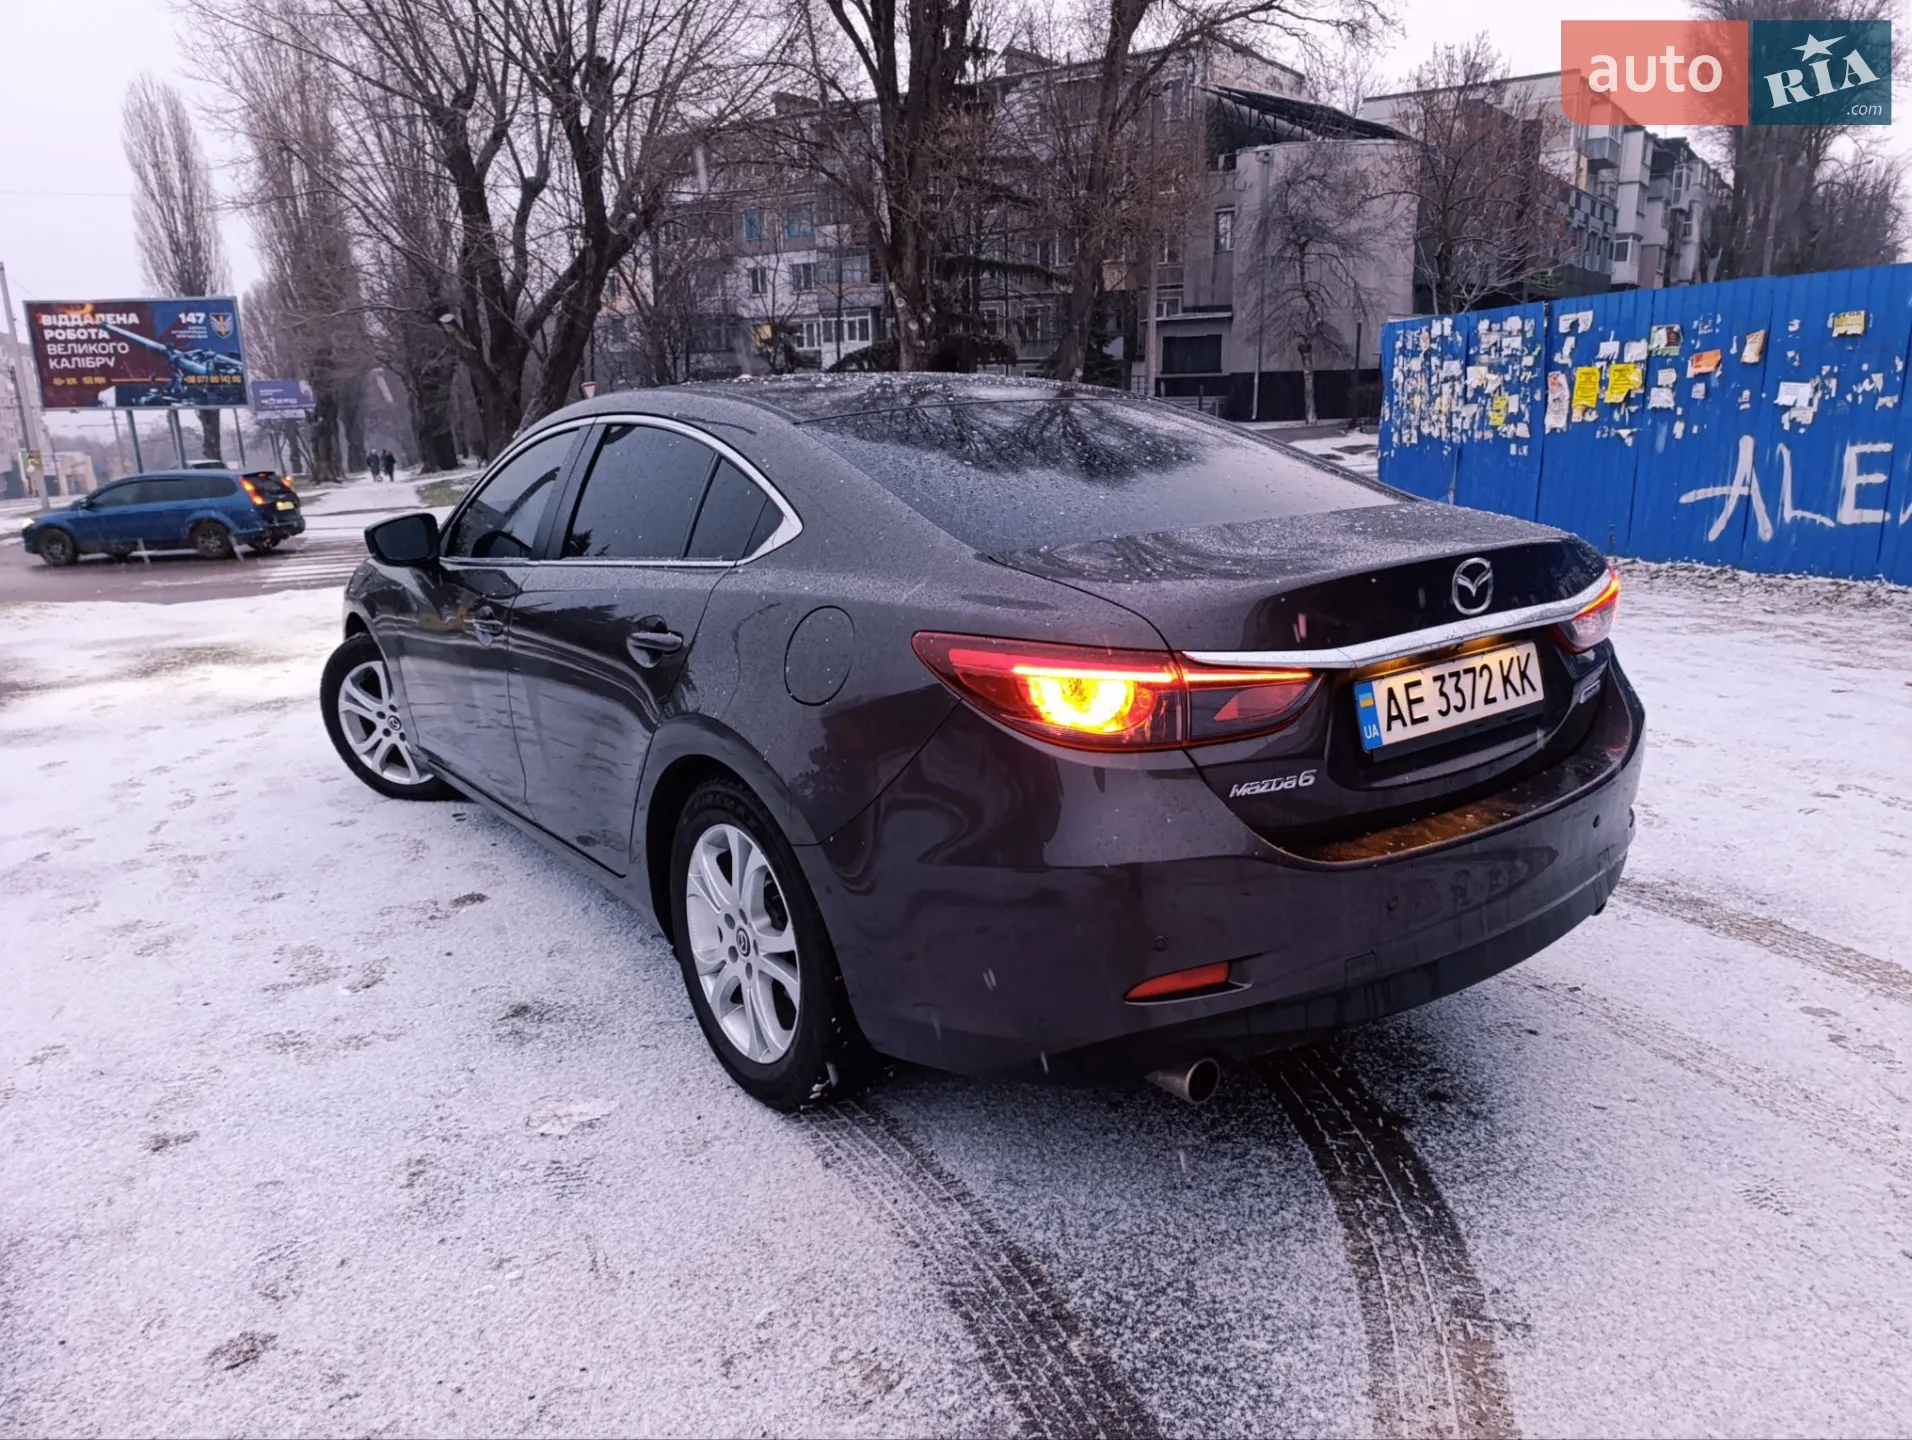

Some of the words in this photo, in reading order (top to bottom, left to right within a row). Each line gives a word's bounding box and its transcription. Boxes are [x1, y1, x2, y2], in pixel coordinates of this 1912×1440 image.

[41, 312, 140, 327] ВІДДАЛЕНА
[178, 312, 206, 324] 147
[43, 328, 110, 341] РОБОТА
[46, 342, 130, 355] ВЕЛИКОГО
[48, 356, 116, 370] КАЛІБРУ
[1679, 435, 1912, 542] ALE
[1386, 679, 1430, 732] AE
[1432, 663, 1498, 717] 3372
[1499, 653, 1538, 700] KK
[1363, 724, 1380, 739] UA
